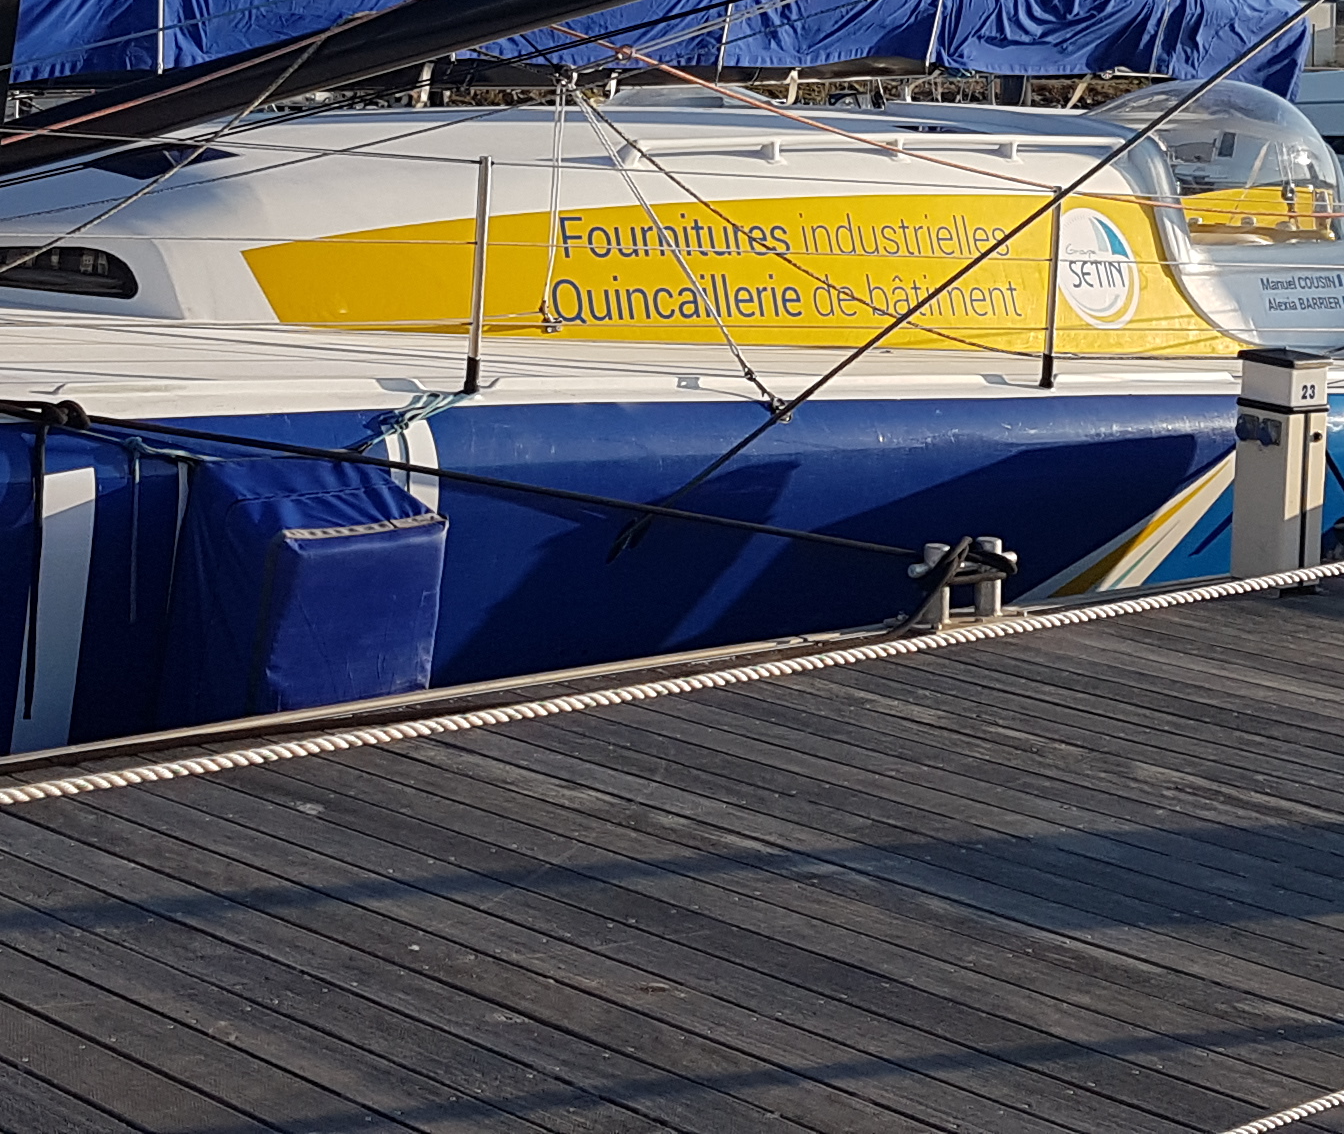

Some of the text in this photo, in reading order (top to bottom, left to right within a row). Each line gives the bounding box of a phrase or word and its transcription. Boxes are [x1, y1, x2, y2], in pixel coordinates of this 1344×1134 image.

[559, 212, 1011, 259] Fournitures industrielles
[1068, 260, 1126, 289] SETIN
[1260, 274, 1338, 291] Manuel COUSIN
[552, 273, 1023, 325] Quincaillerie de bâtiment
[1297, 296, 1342, 311] BARRIER
[1301, 384, 1316, 400] 23
